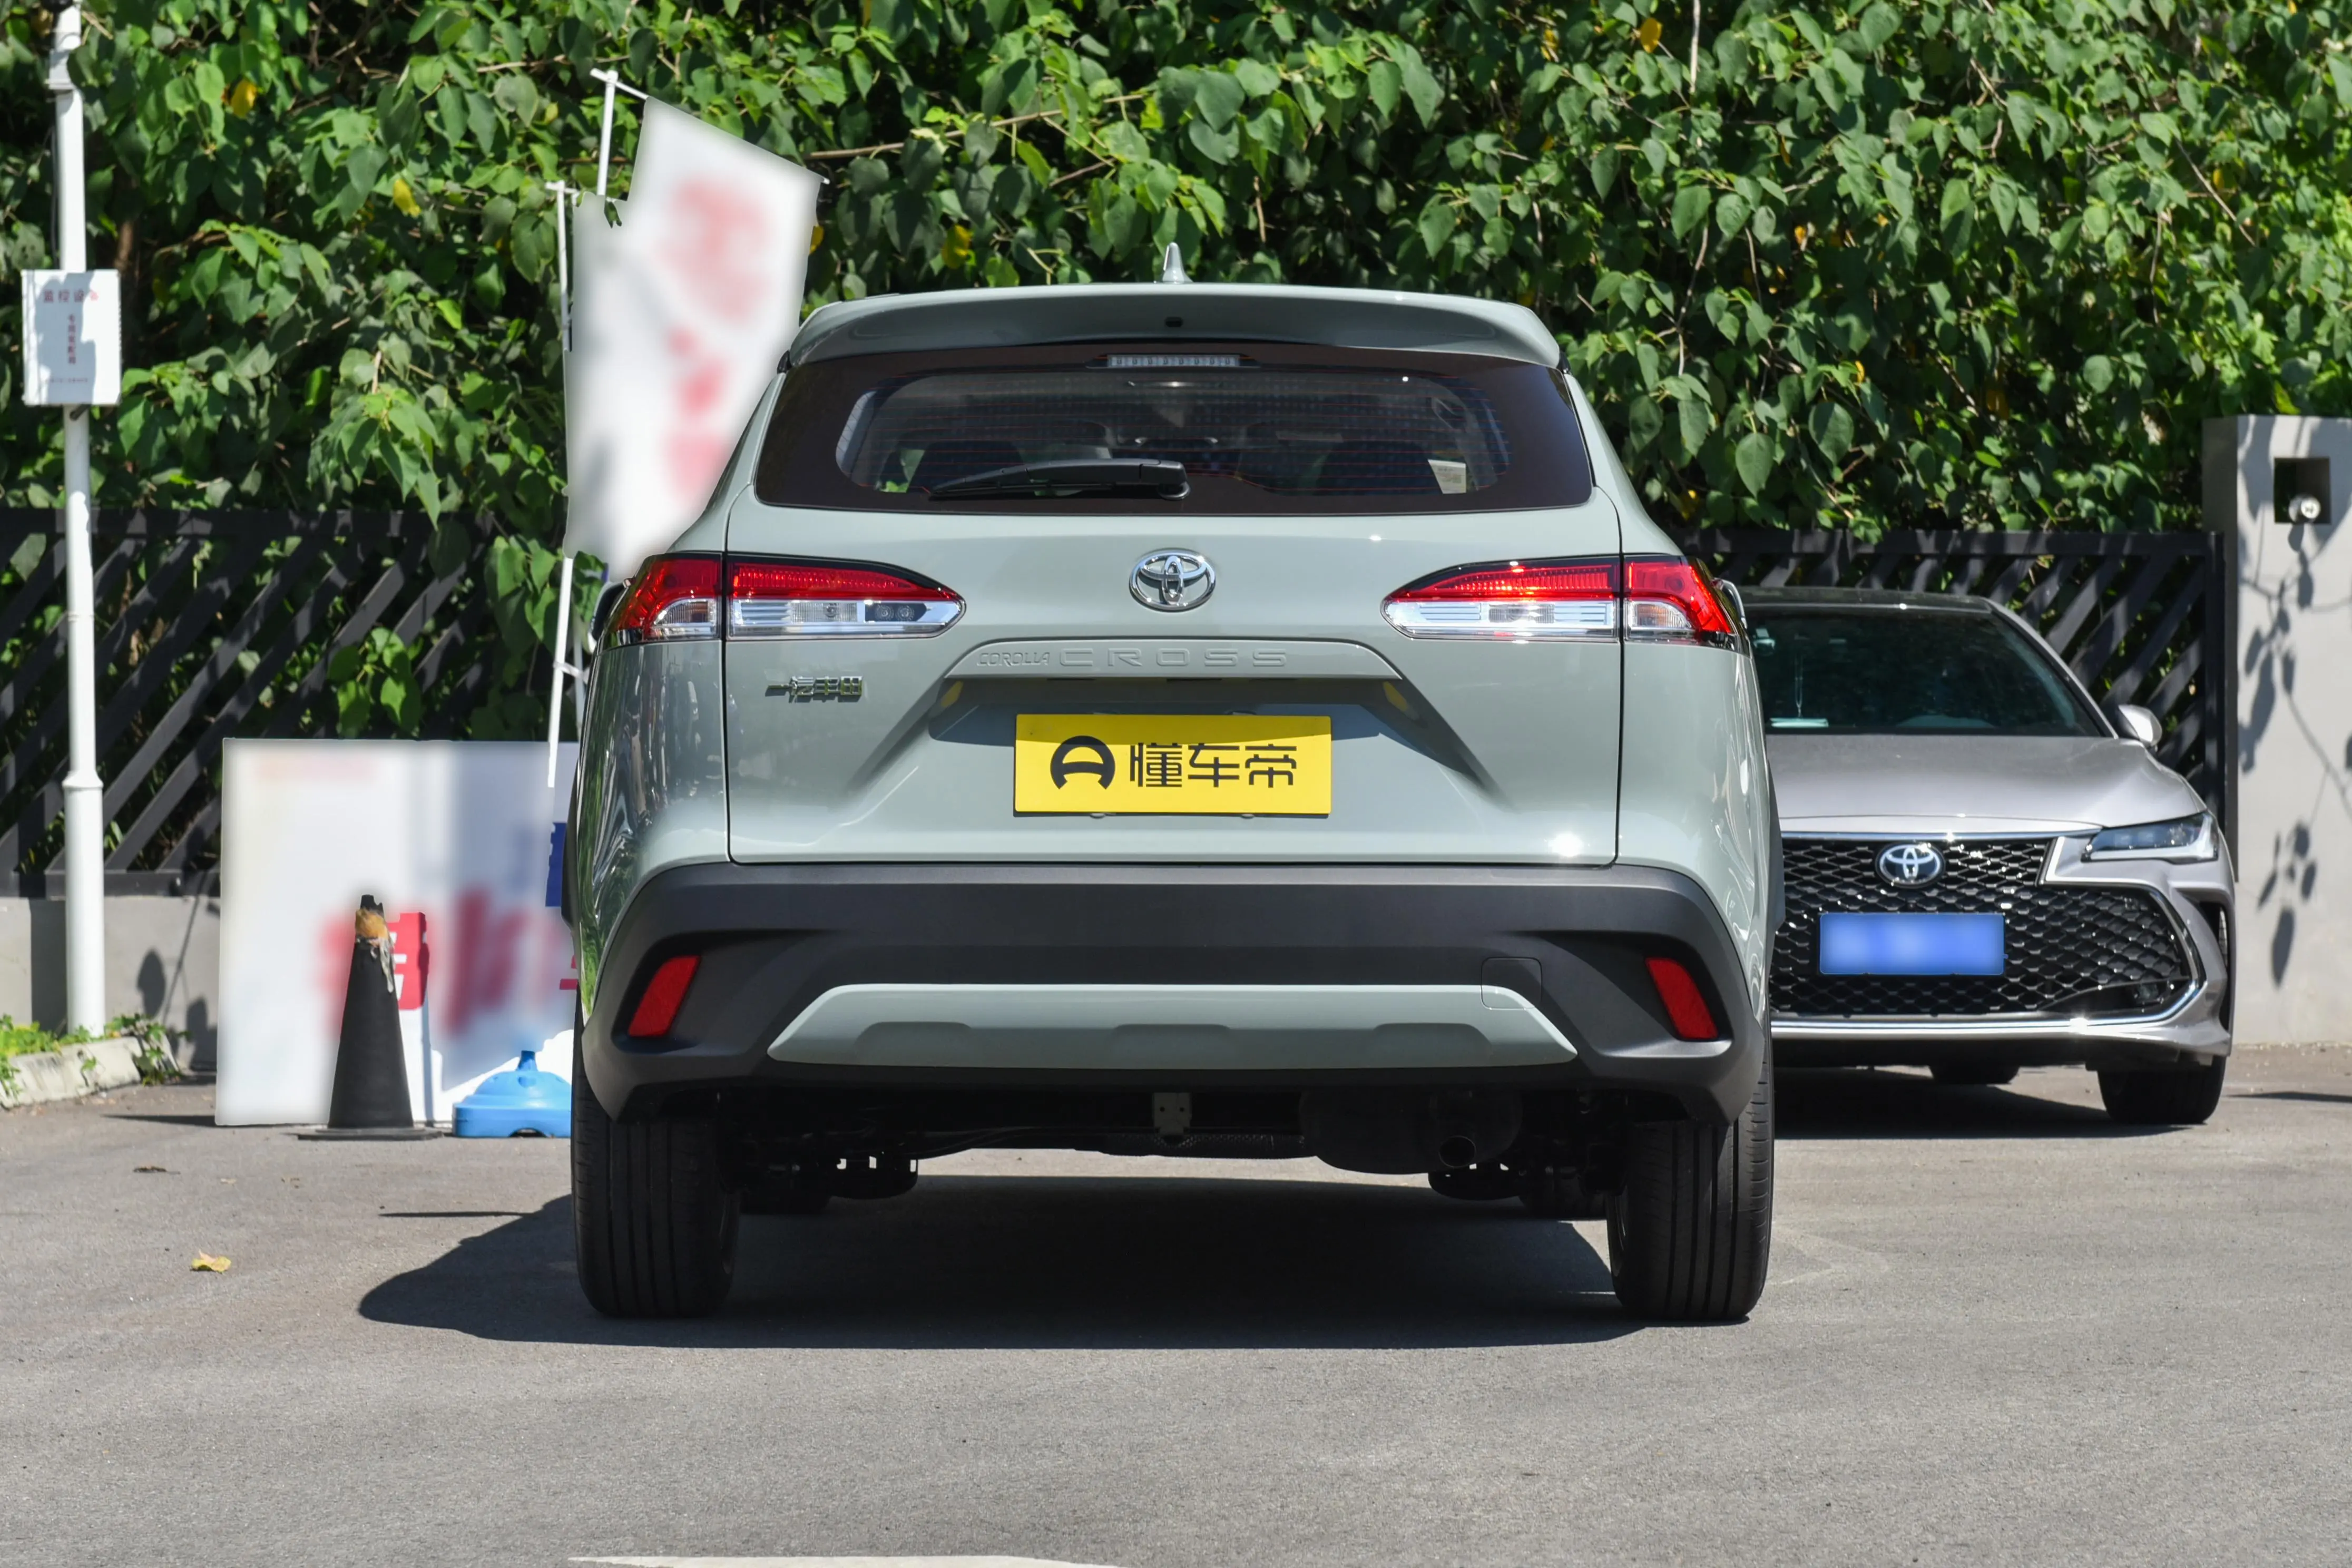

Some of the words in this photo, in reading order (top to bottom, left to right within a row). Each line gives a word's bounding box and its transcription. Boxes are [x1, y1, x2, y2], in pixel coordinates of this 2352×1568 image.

[976, 652, 1051, 667] COROLLA
[1059, 648, 1288, 667] CROSS
[767, 675, 864, 696] 一汽丰田
[1130, 742, 1297, 788] 懂车帝
